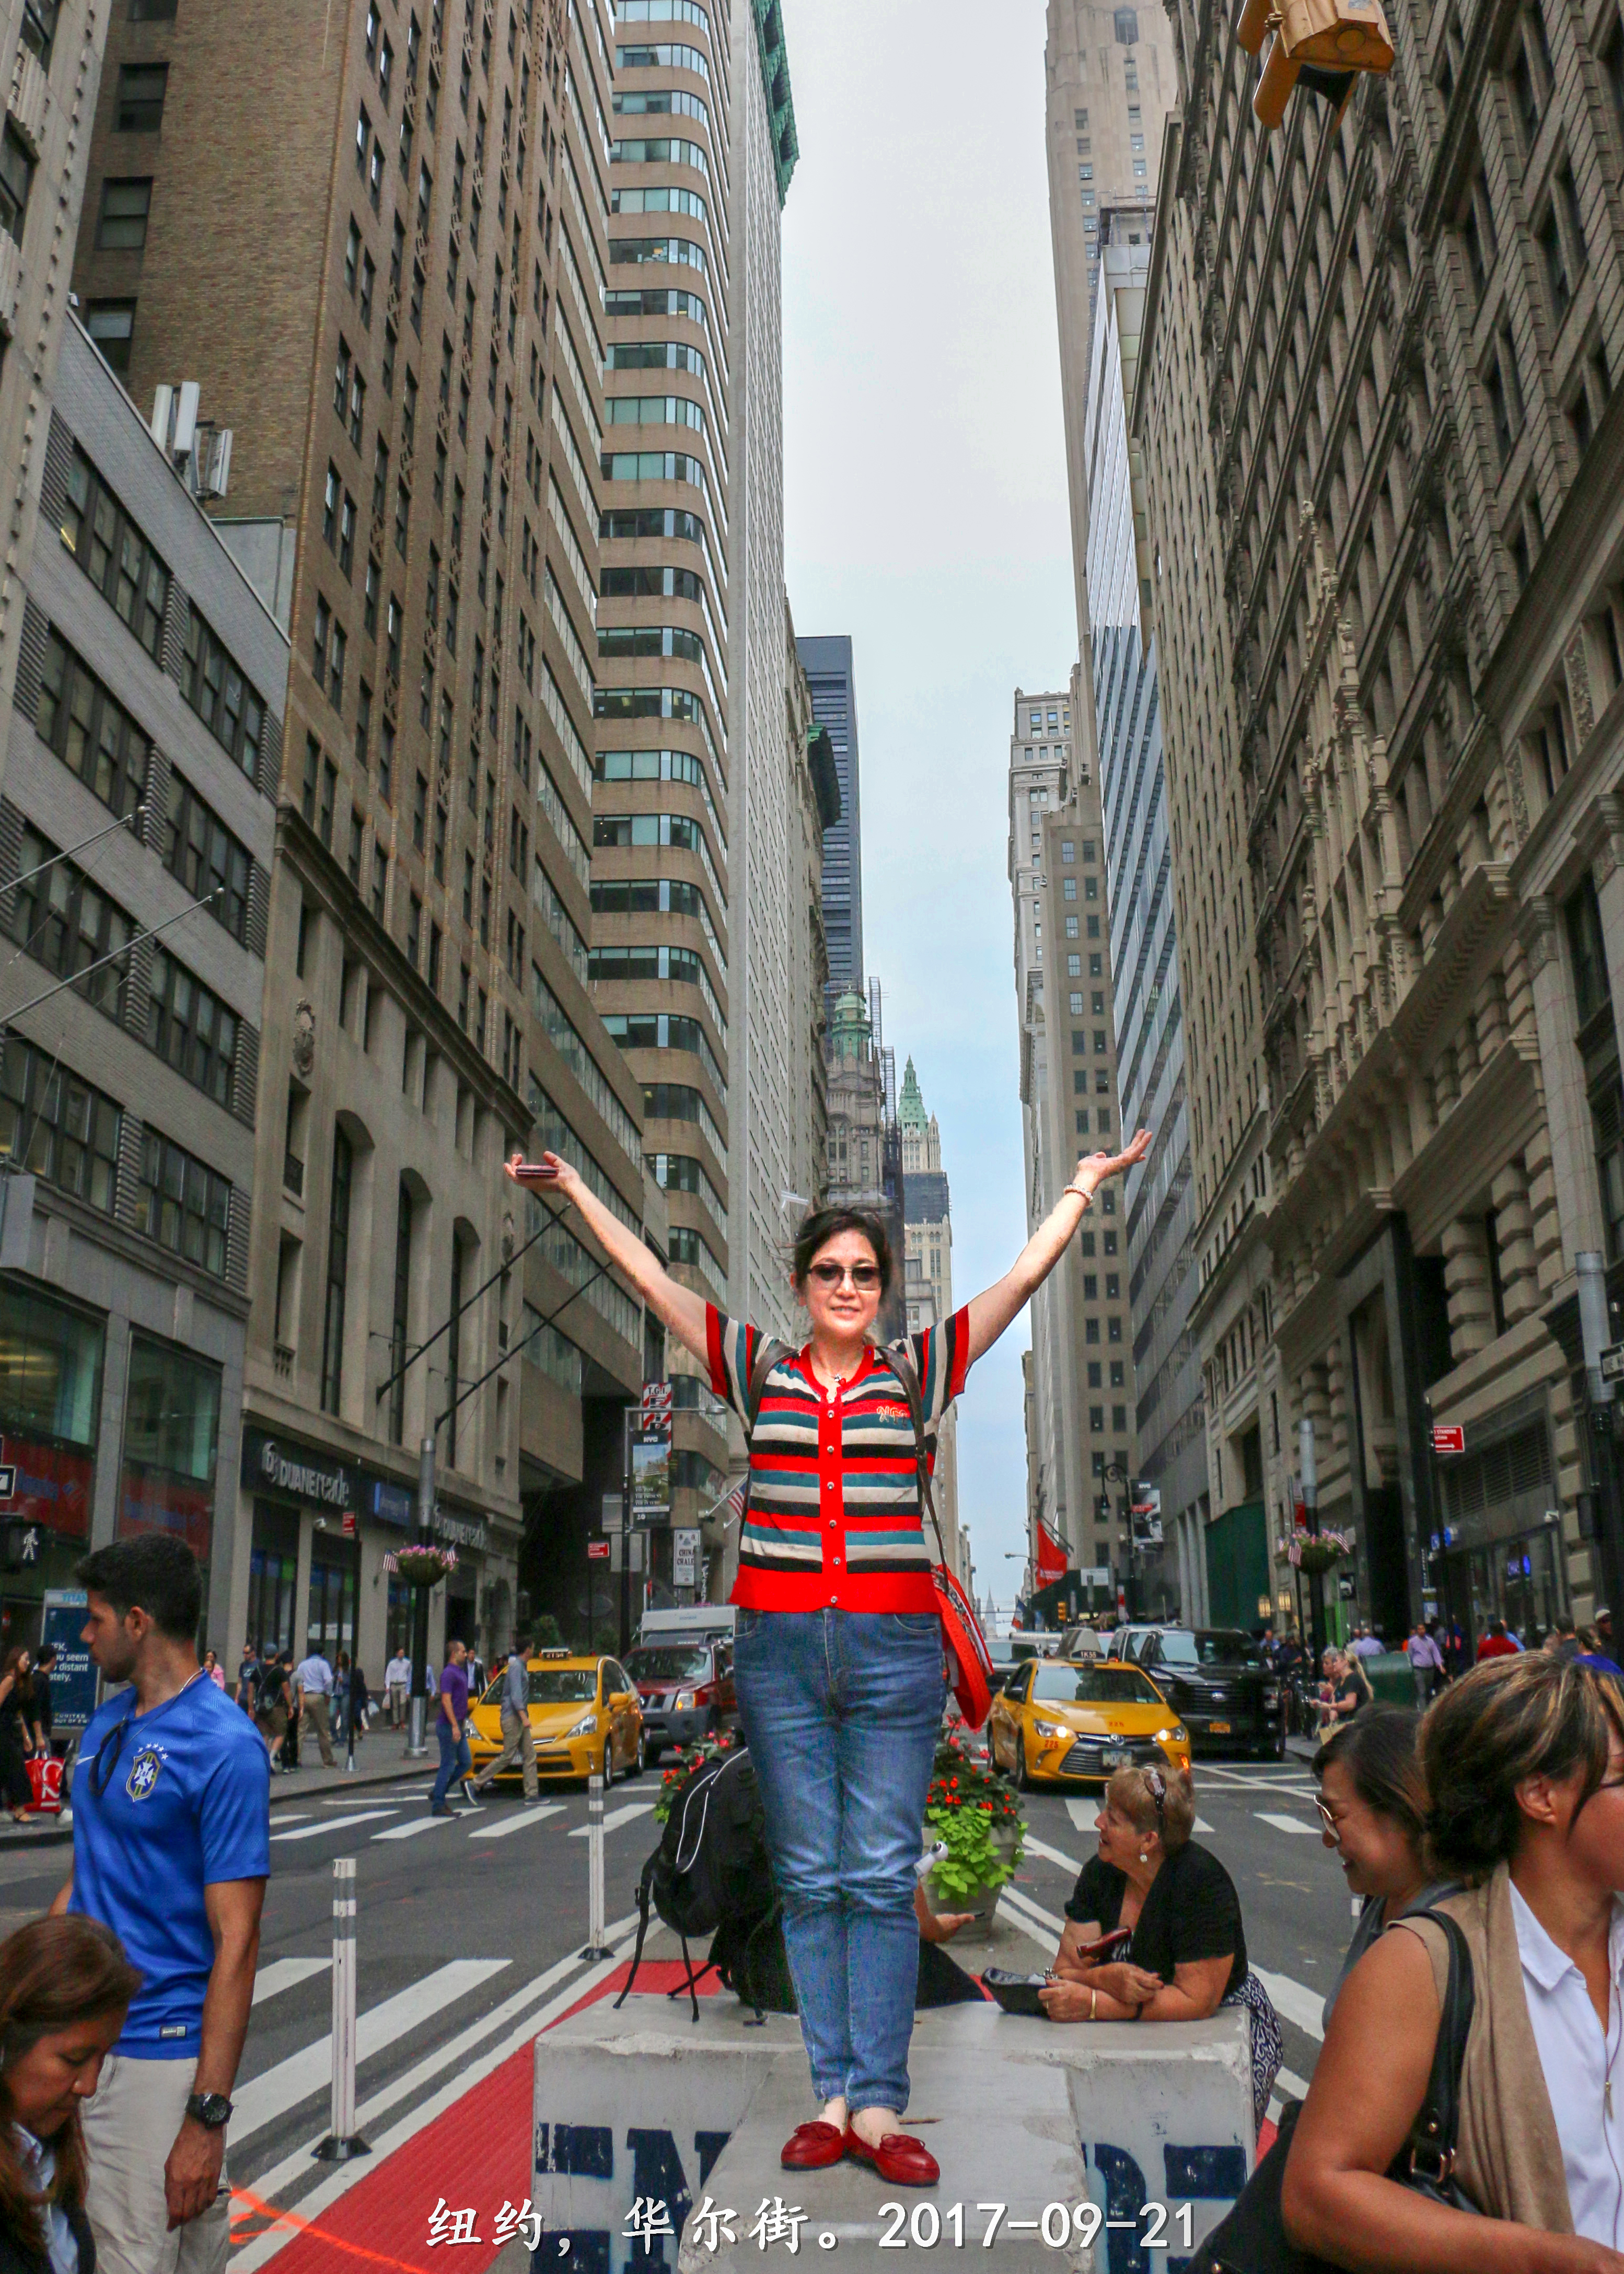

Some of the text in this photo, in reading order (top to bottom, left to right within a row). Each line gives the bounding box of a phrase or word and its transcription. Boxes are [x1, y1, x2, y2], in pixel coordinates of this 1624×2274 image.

[59, 1663, 88, 1672] distant
[49, 1672, 72, 1683] ately.
[1045, 1740, 1058, 1748] 225
